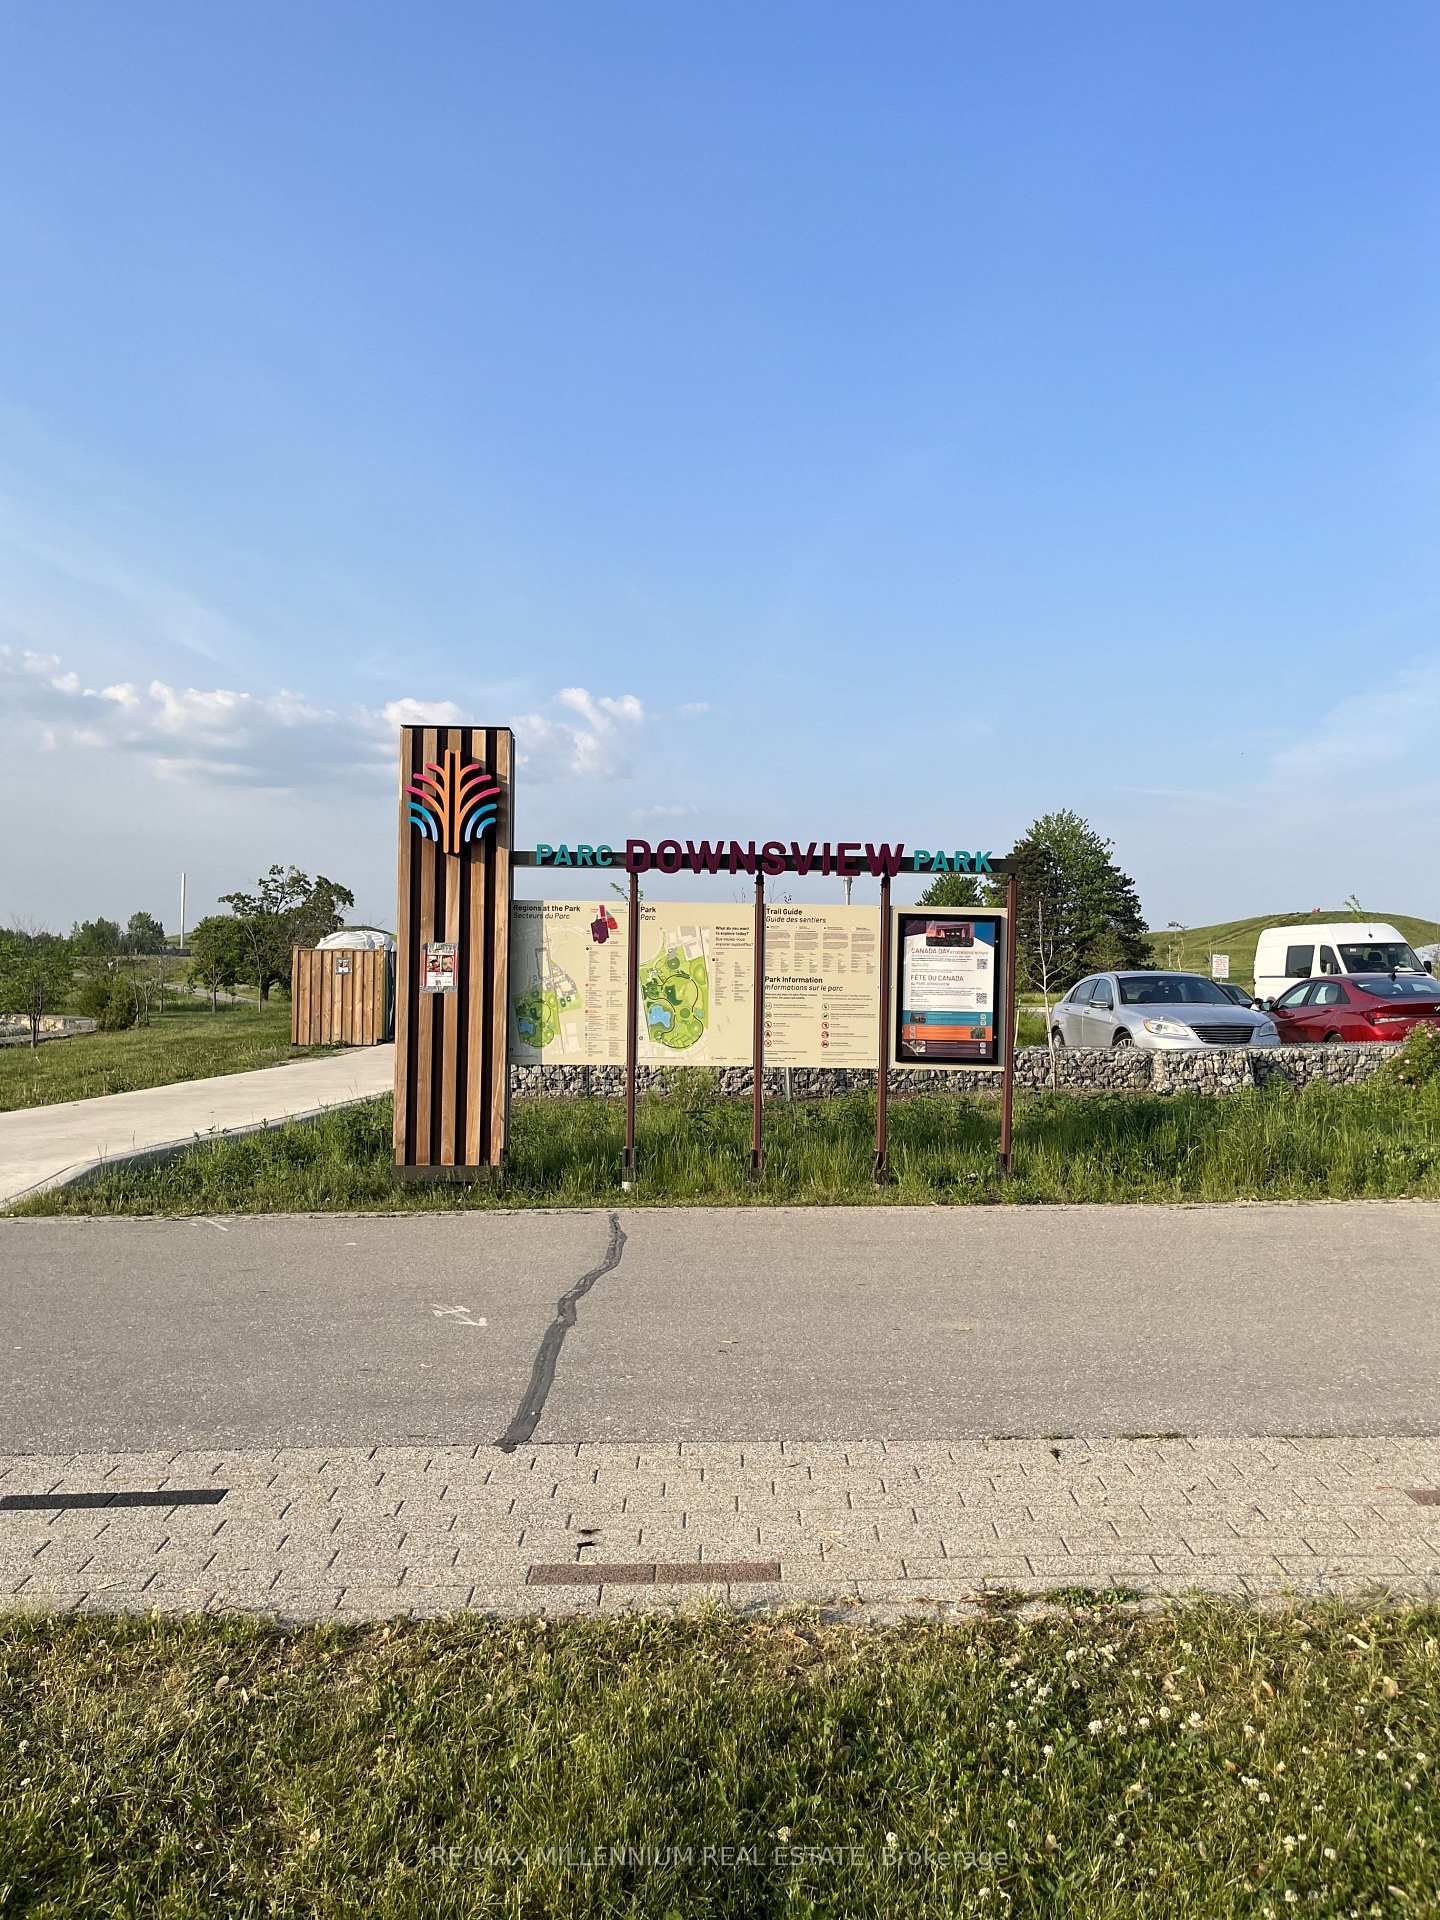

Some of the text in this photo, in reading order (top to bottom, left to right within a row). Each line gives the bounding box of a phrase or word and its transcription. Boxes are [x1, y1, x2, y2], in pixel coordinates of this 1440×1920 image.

[535, 839, 993, 877] PARC DOWNSVIEW PARK
[513, 905, 542, 913] Regions
[766, 915, 785, 923] Guide
